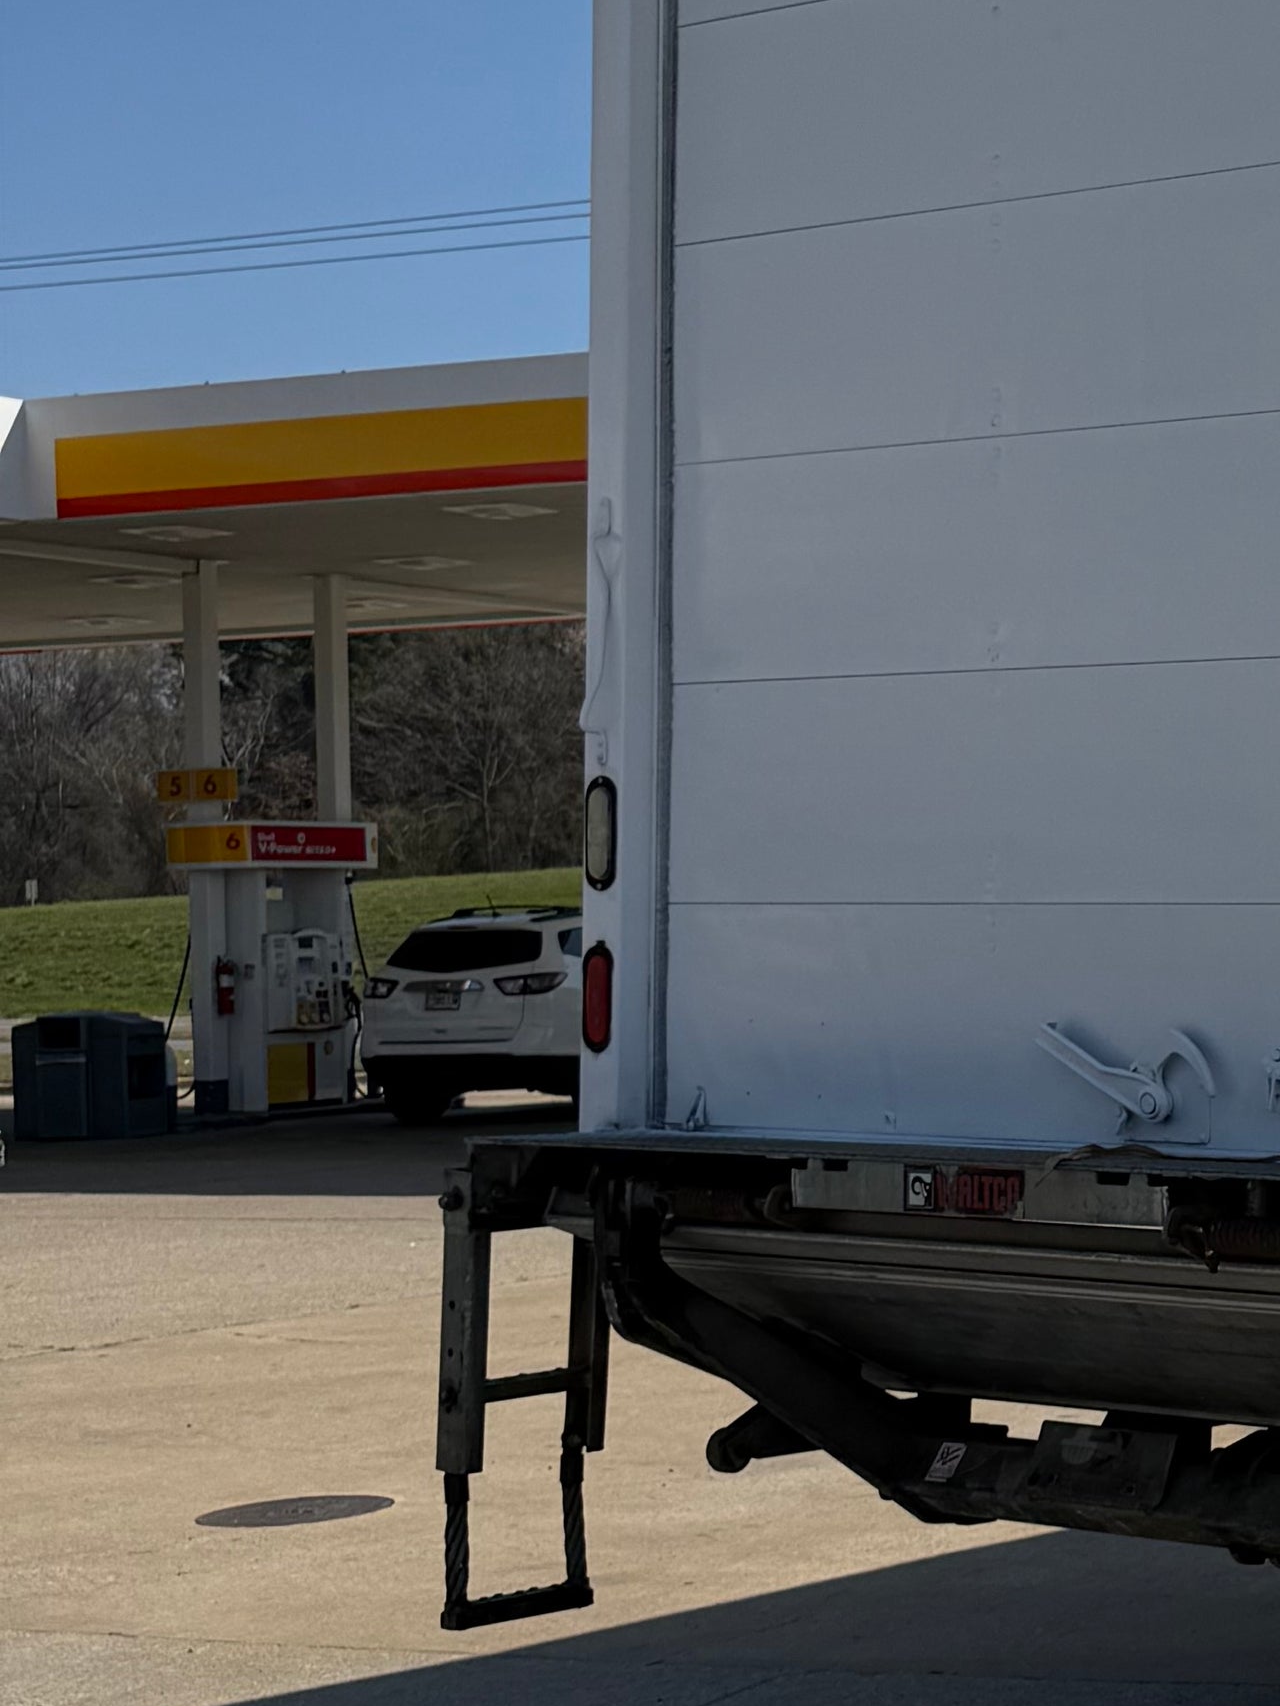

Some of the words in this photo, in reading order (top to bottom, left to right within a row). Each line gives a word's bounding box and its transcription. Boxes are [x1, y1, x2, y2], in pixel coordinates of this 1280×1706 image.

[169, 776, 182, 796] 5
[203, 774, 217, 795] 6
[226, 833, 241, 850] 6
[257, 841, 304, 854] V-Power
